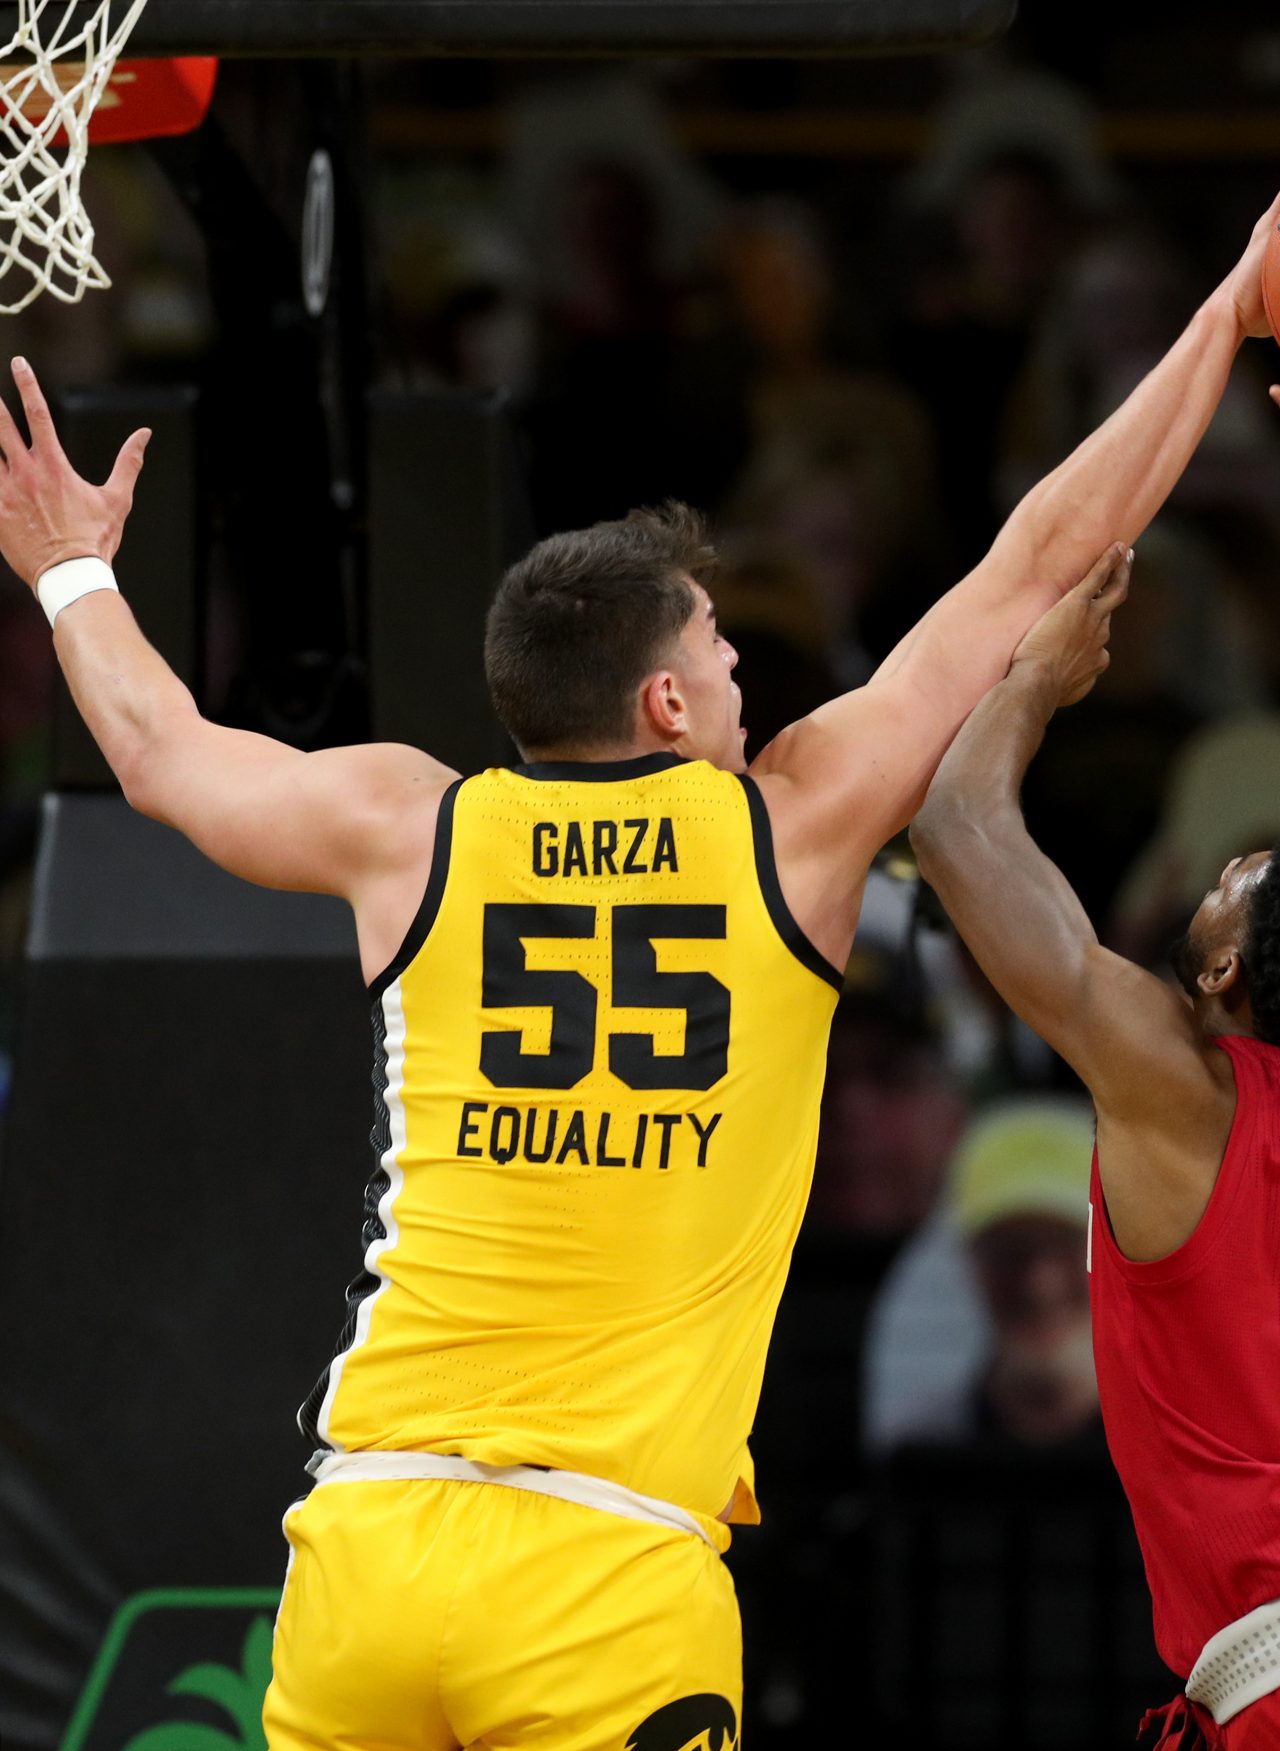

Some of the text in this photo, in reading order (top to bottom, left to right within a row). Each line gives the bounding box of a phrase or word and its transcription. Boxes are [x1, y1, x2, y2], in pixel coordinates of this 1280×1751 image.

[533, 818, 678, 877] GARZA
[479, 904, 730, 1091] 55
[457, 1103, 721, 1168] EQUALITY
